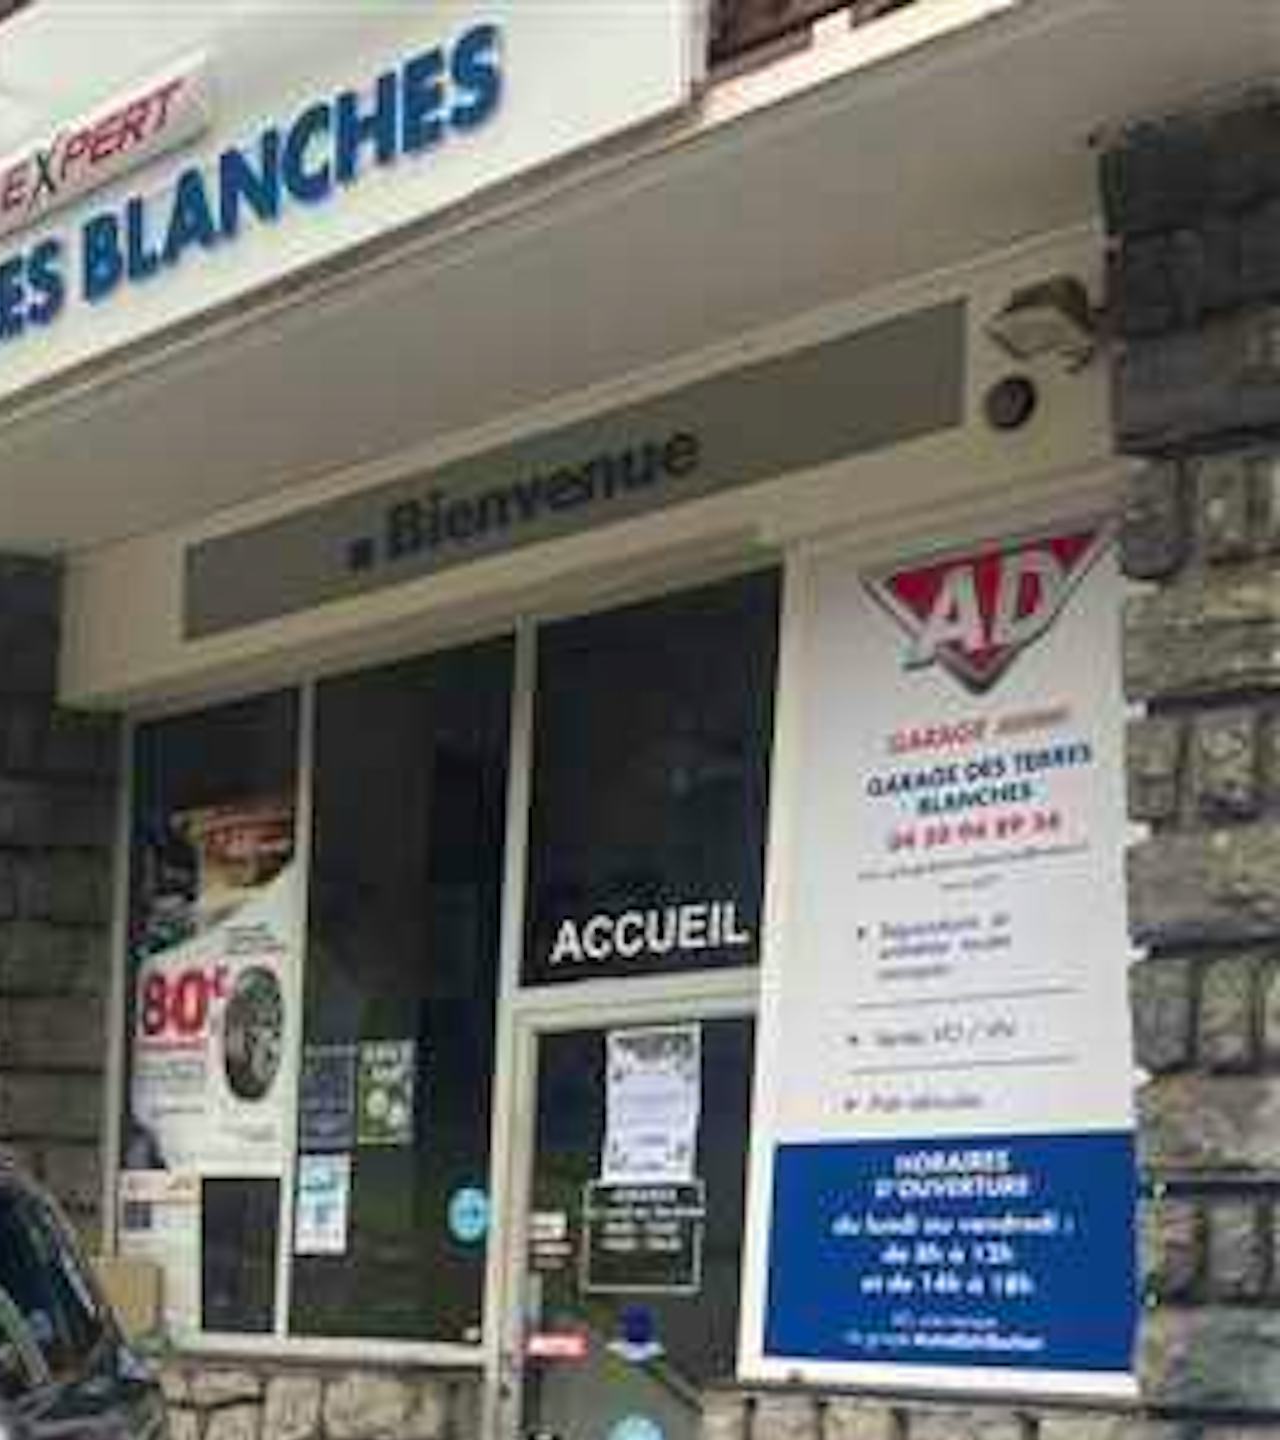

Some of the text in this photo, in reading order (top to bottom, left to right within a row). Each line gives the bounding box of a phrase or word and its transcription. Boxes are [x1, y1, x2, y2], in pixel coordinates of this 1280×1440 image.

[0, 76, 184, 212] EXPERT
[82, 24, 503, 302] BLANCHES
[384, 427, 701, 561] Bienvenue
[919, 546, 1070, 656] AD
[868, 764, 958, 797] GARAGE
[965, 755, 1007, 778] DES
[549, 900, 750, 964] ACCUEIL
[874, 1175, 1029, 1199] D'OUVERTURE
[894, 1150, 1011, 1175] HORAIRES
